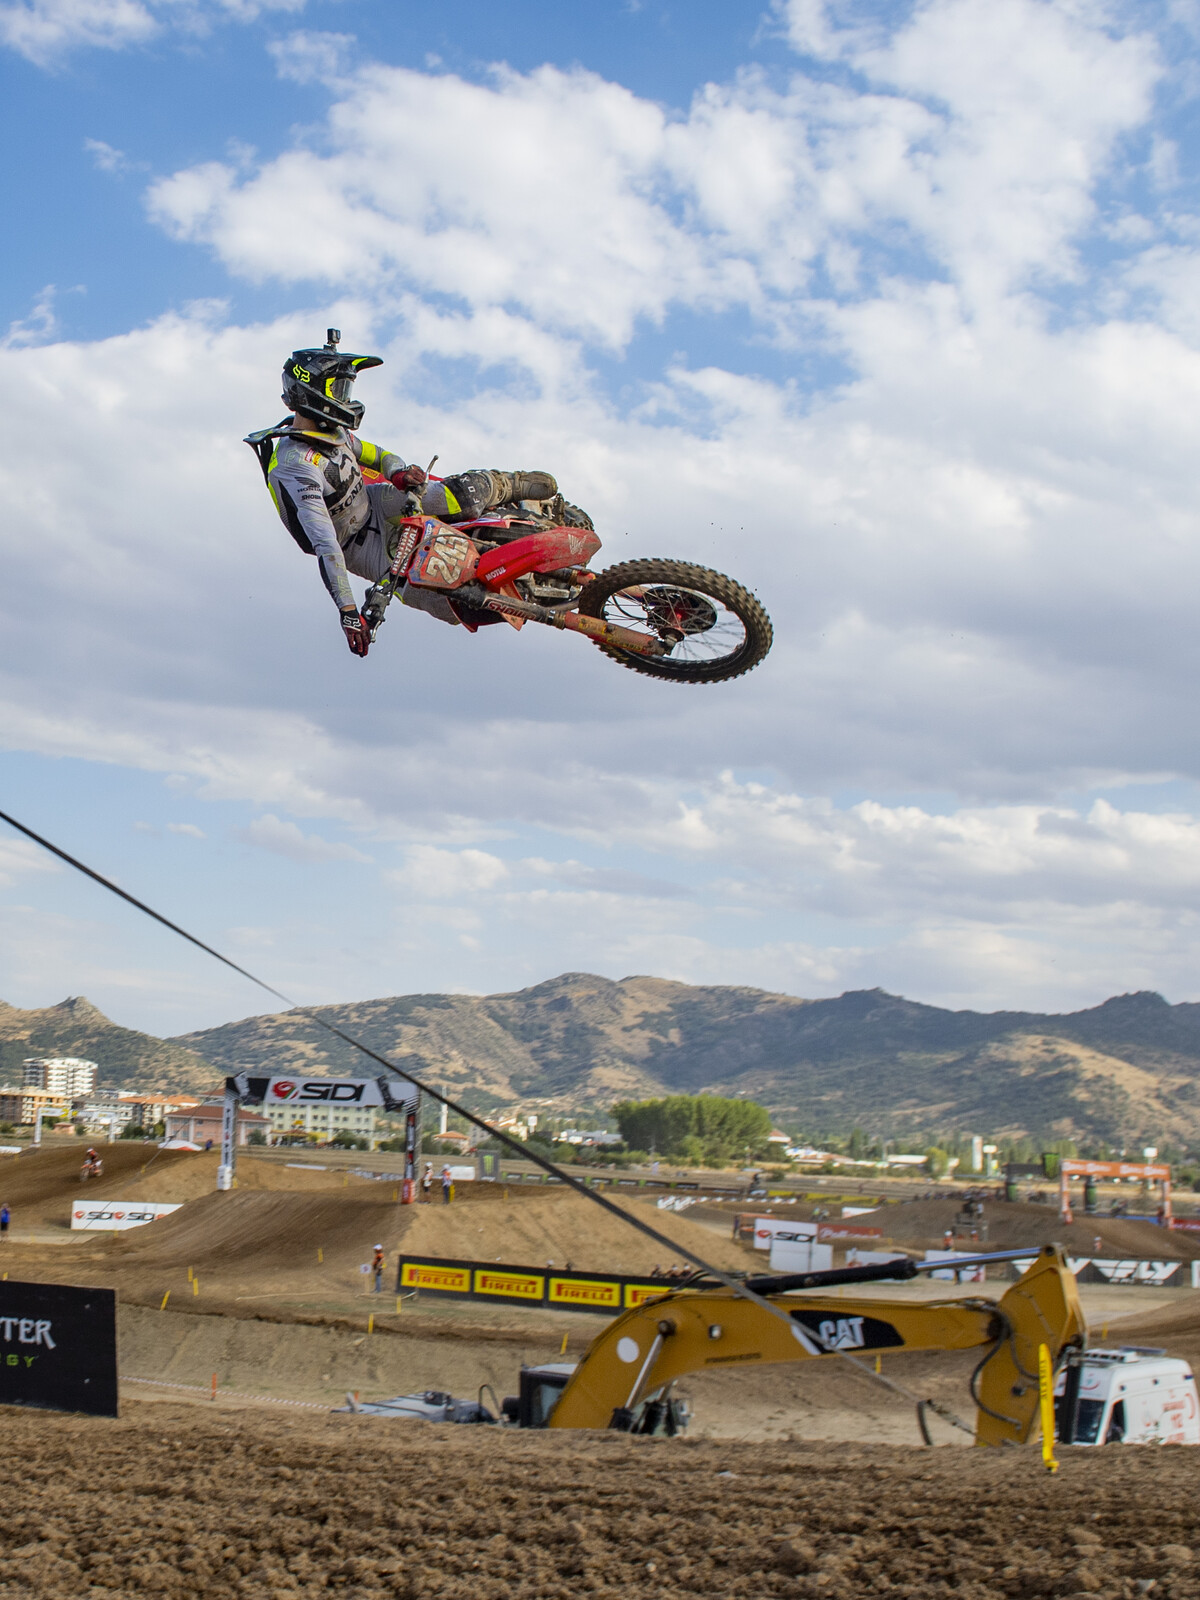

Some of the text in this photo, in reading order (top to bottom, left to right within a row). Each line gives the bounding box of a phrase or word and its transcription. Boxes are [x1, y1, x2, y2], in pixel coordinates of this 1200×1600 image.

[485, 566, 507, 582] MOTUL
[408, 1268, 464, 1287] PIRELLI
[480, 1275, 538, 1294] PIRELLI
[555, 1282, 613, 1302] PIRELLI
[819, 1317, 865, 1350] CAT
